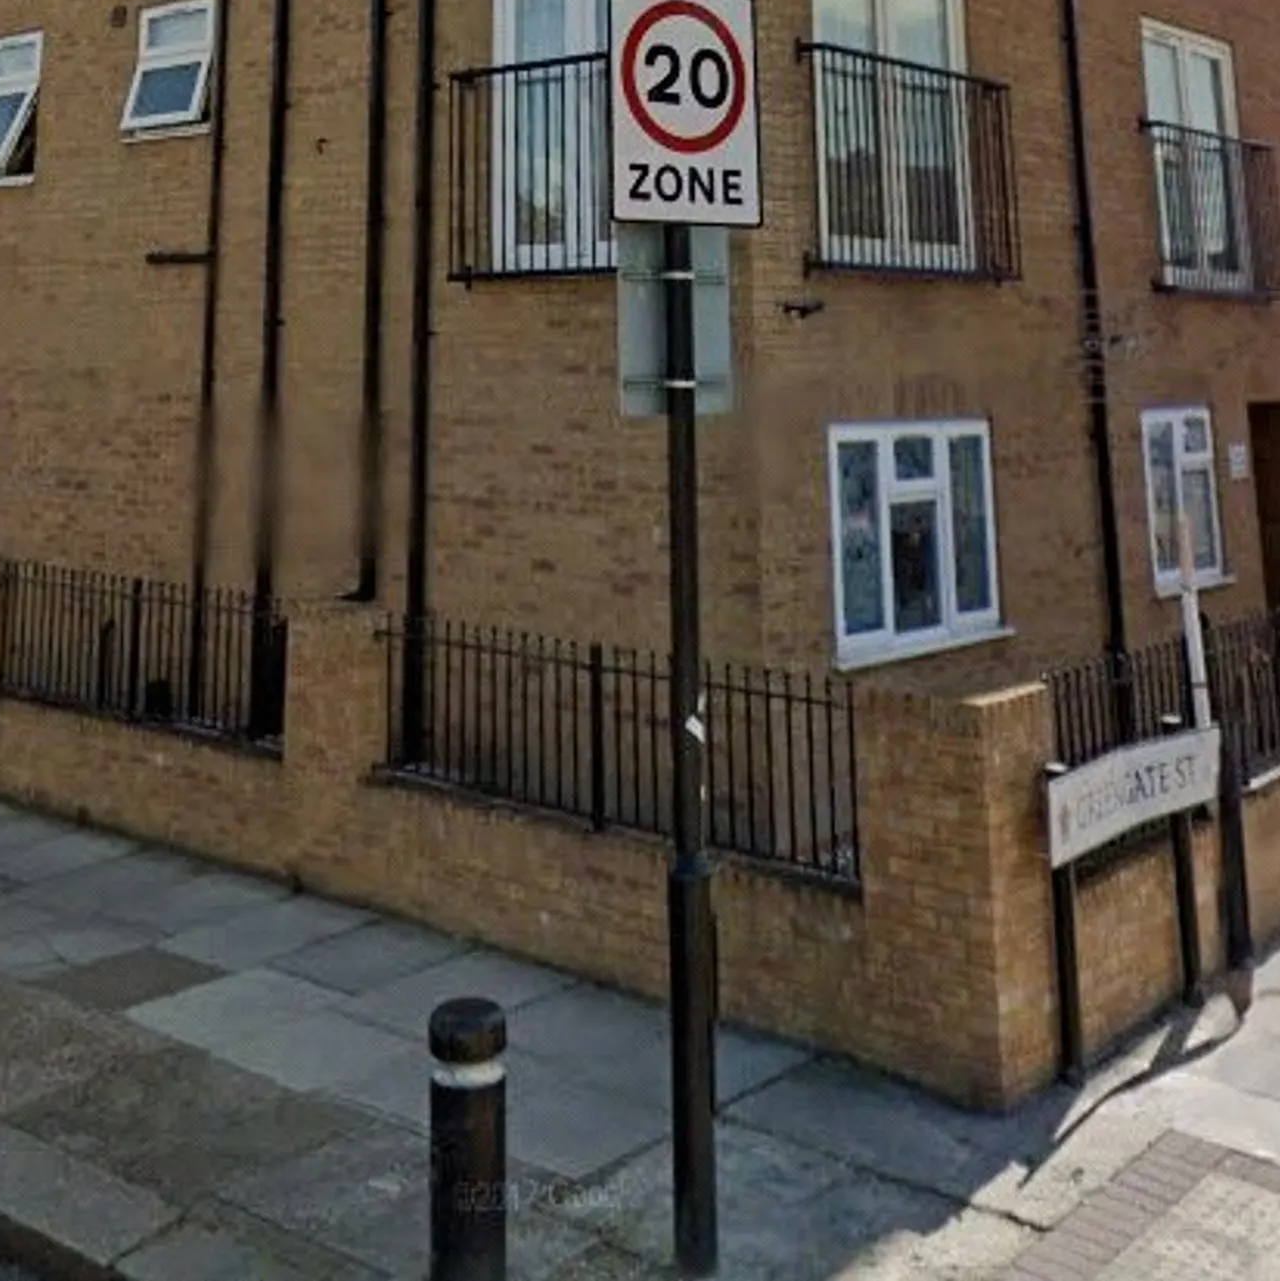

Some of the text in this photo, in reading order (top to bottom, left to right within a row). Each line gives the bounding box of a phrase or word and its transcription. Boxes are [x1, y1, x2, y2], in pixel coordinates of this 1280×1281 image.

[644, 43, 729, 109] 20
[629, 163, 743, 206] ZONE
[1175, 755, 1197, 789] ST
